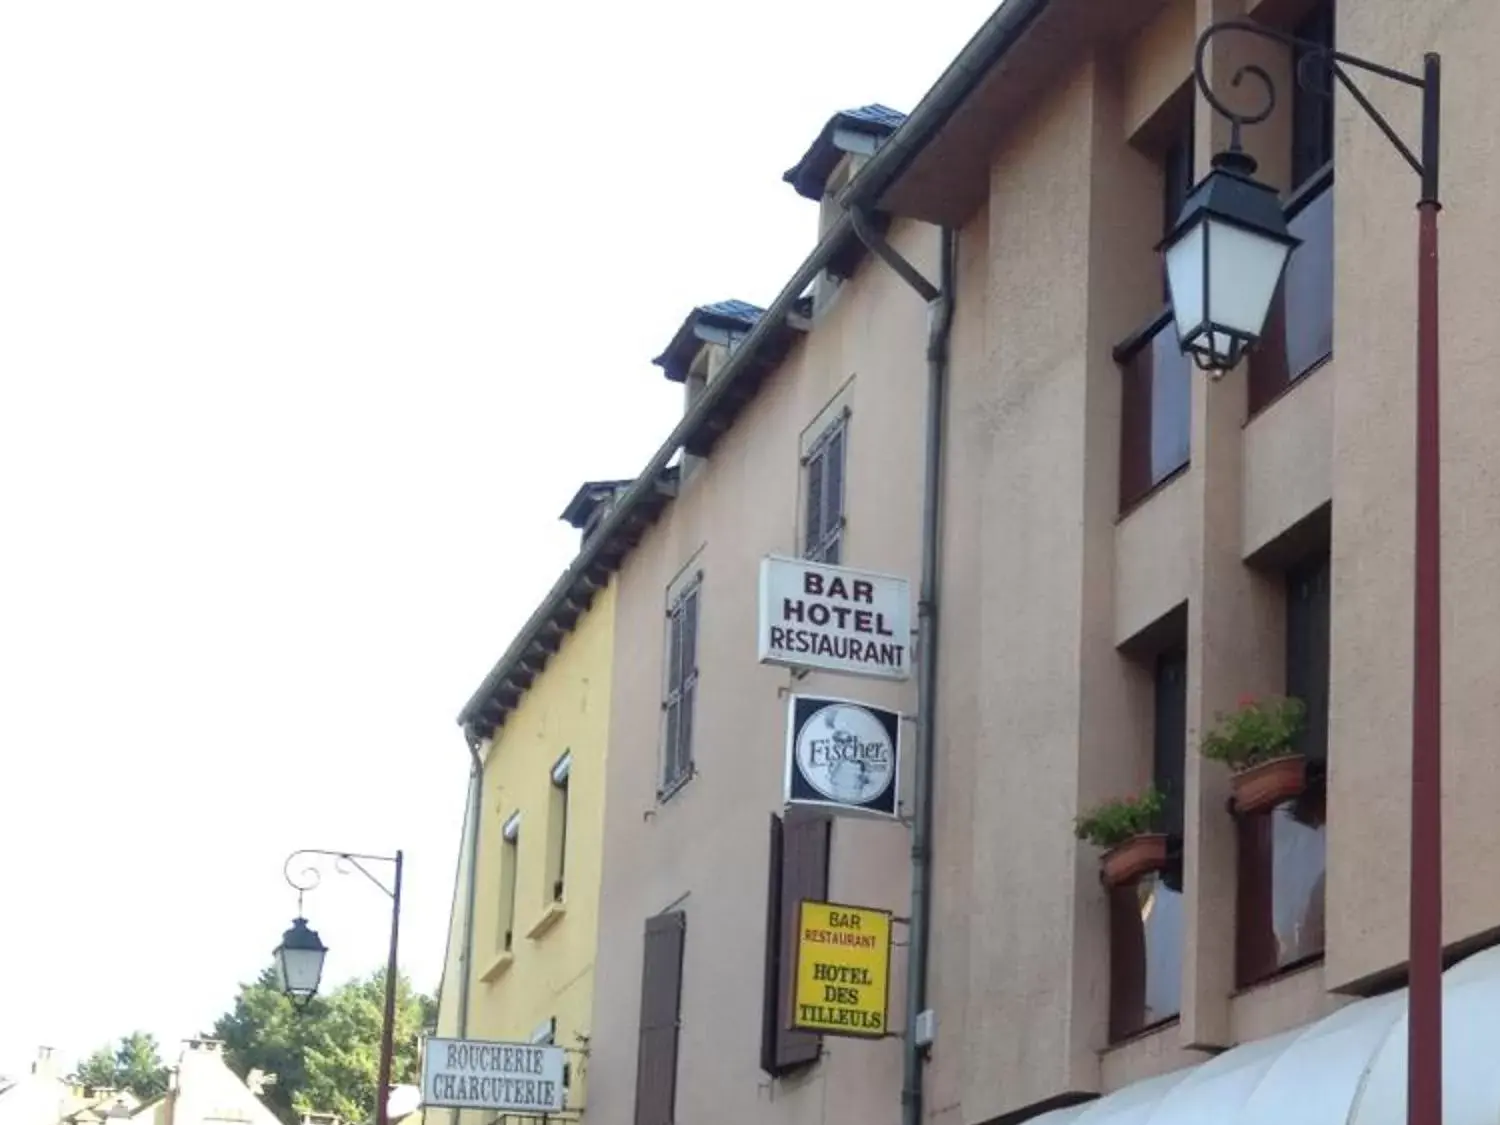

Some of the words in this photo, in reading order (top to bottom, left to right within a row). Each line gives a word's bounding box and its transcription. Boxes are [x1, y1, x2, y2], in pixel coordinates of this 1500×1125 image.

[804, 571, 874, 604] BAR
[783, 598, 893, 637] HOTEL
[770, 625, 904, 667] RESTAURANT
[809, 735, 884, 768] Fischer
[829, 912, 861, 929] BAR
[804, 928, 877, 949] RESTAURANT
[812, 962, 873, 985] HOTEL
[824, 984, 859, 1005] DES
[799, 1003, 882, 1028] TILLEULS
[446, 1043, 545, 1074] BOUCHERIE
[433, 1073, 555, 1106] CHARCUTERIE
